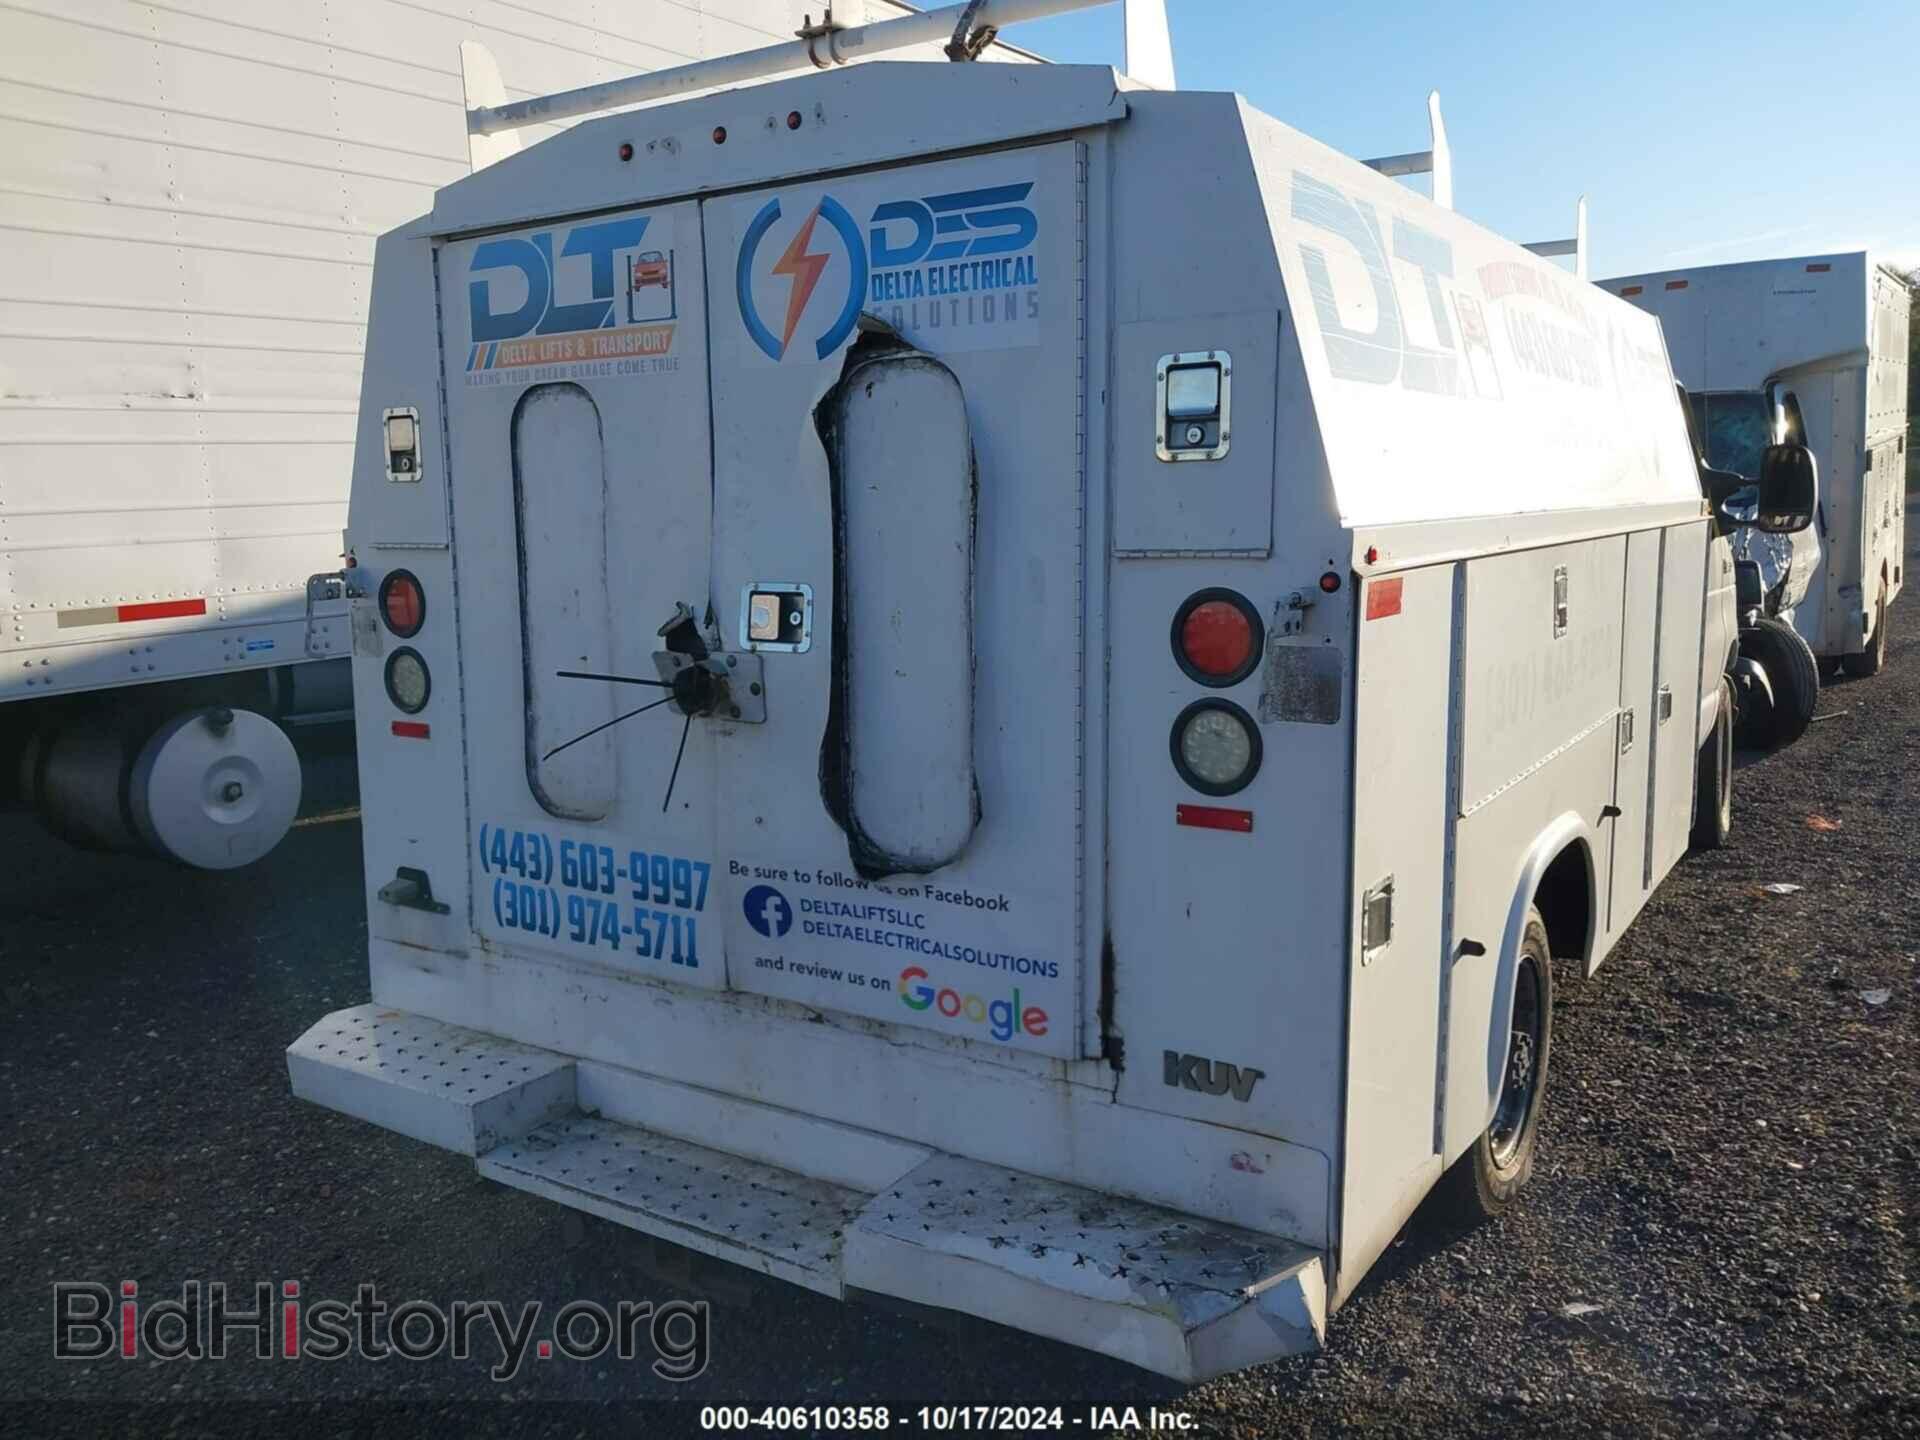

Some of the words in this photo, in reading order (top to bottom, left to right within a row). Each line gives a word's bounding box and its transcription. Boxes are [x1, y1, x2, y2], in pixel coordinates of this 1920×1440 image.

[870, 181, 1038, 268] DES
[470, 216, 652, 342] DLT
[871, 267, 924, 301] DELTA
[928, 255, 1038, 295] ELECTRICAL
[501, 342, 537, 365] DELTA
[539, 339, 573, 360] LIFTS
[577, 339, 587, 357] &
[592, 331, 669, 357] TRANSPORT
[505, 368, 533, 384] YOUR
[568, 362, 612, 379] GARAGE
[616, 359, 646, 376] COME
[652, 357, 680, 373] TRUE
[479, 823, 553, 885] (443)
[560, 839, 712, 912] 603-9997
[729, 860, 750, 877] Be
[754, 866, 788, 882] sure
[795, 866, 812, 884] to
[816, 869, 869, 891] follow
[897, 886, 919, 898] on
[924, 885, 1010, 913] Facebook
[494, 877, 561, 939] (301)
[568, 894, 699, 968] 974-5711
[800, 898, 926, 930] DELTALIFTSLLC
[803, 919, 1059, 979] DELTAELECTRICALSOLUTIONS
[754, 954, 784, 972] and
[789, 961, 843, 982] review
[848, 973, 866, 987] us
[871, 976, 891, 991] on
[899, 966, 1049, 1042] Google
[1164, 1049, 1267, 1103] KUV
